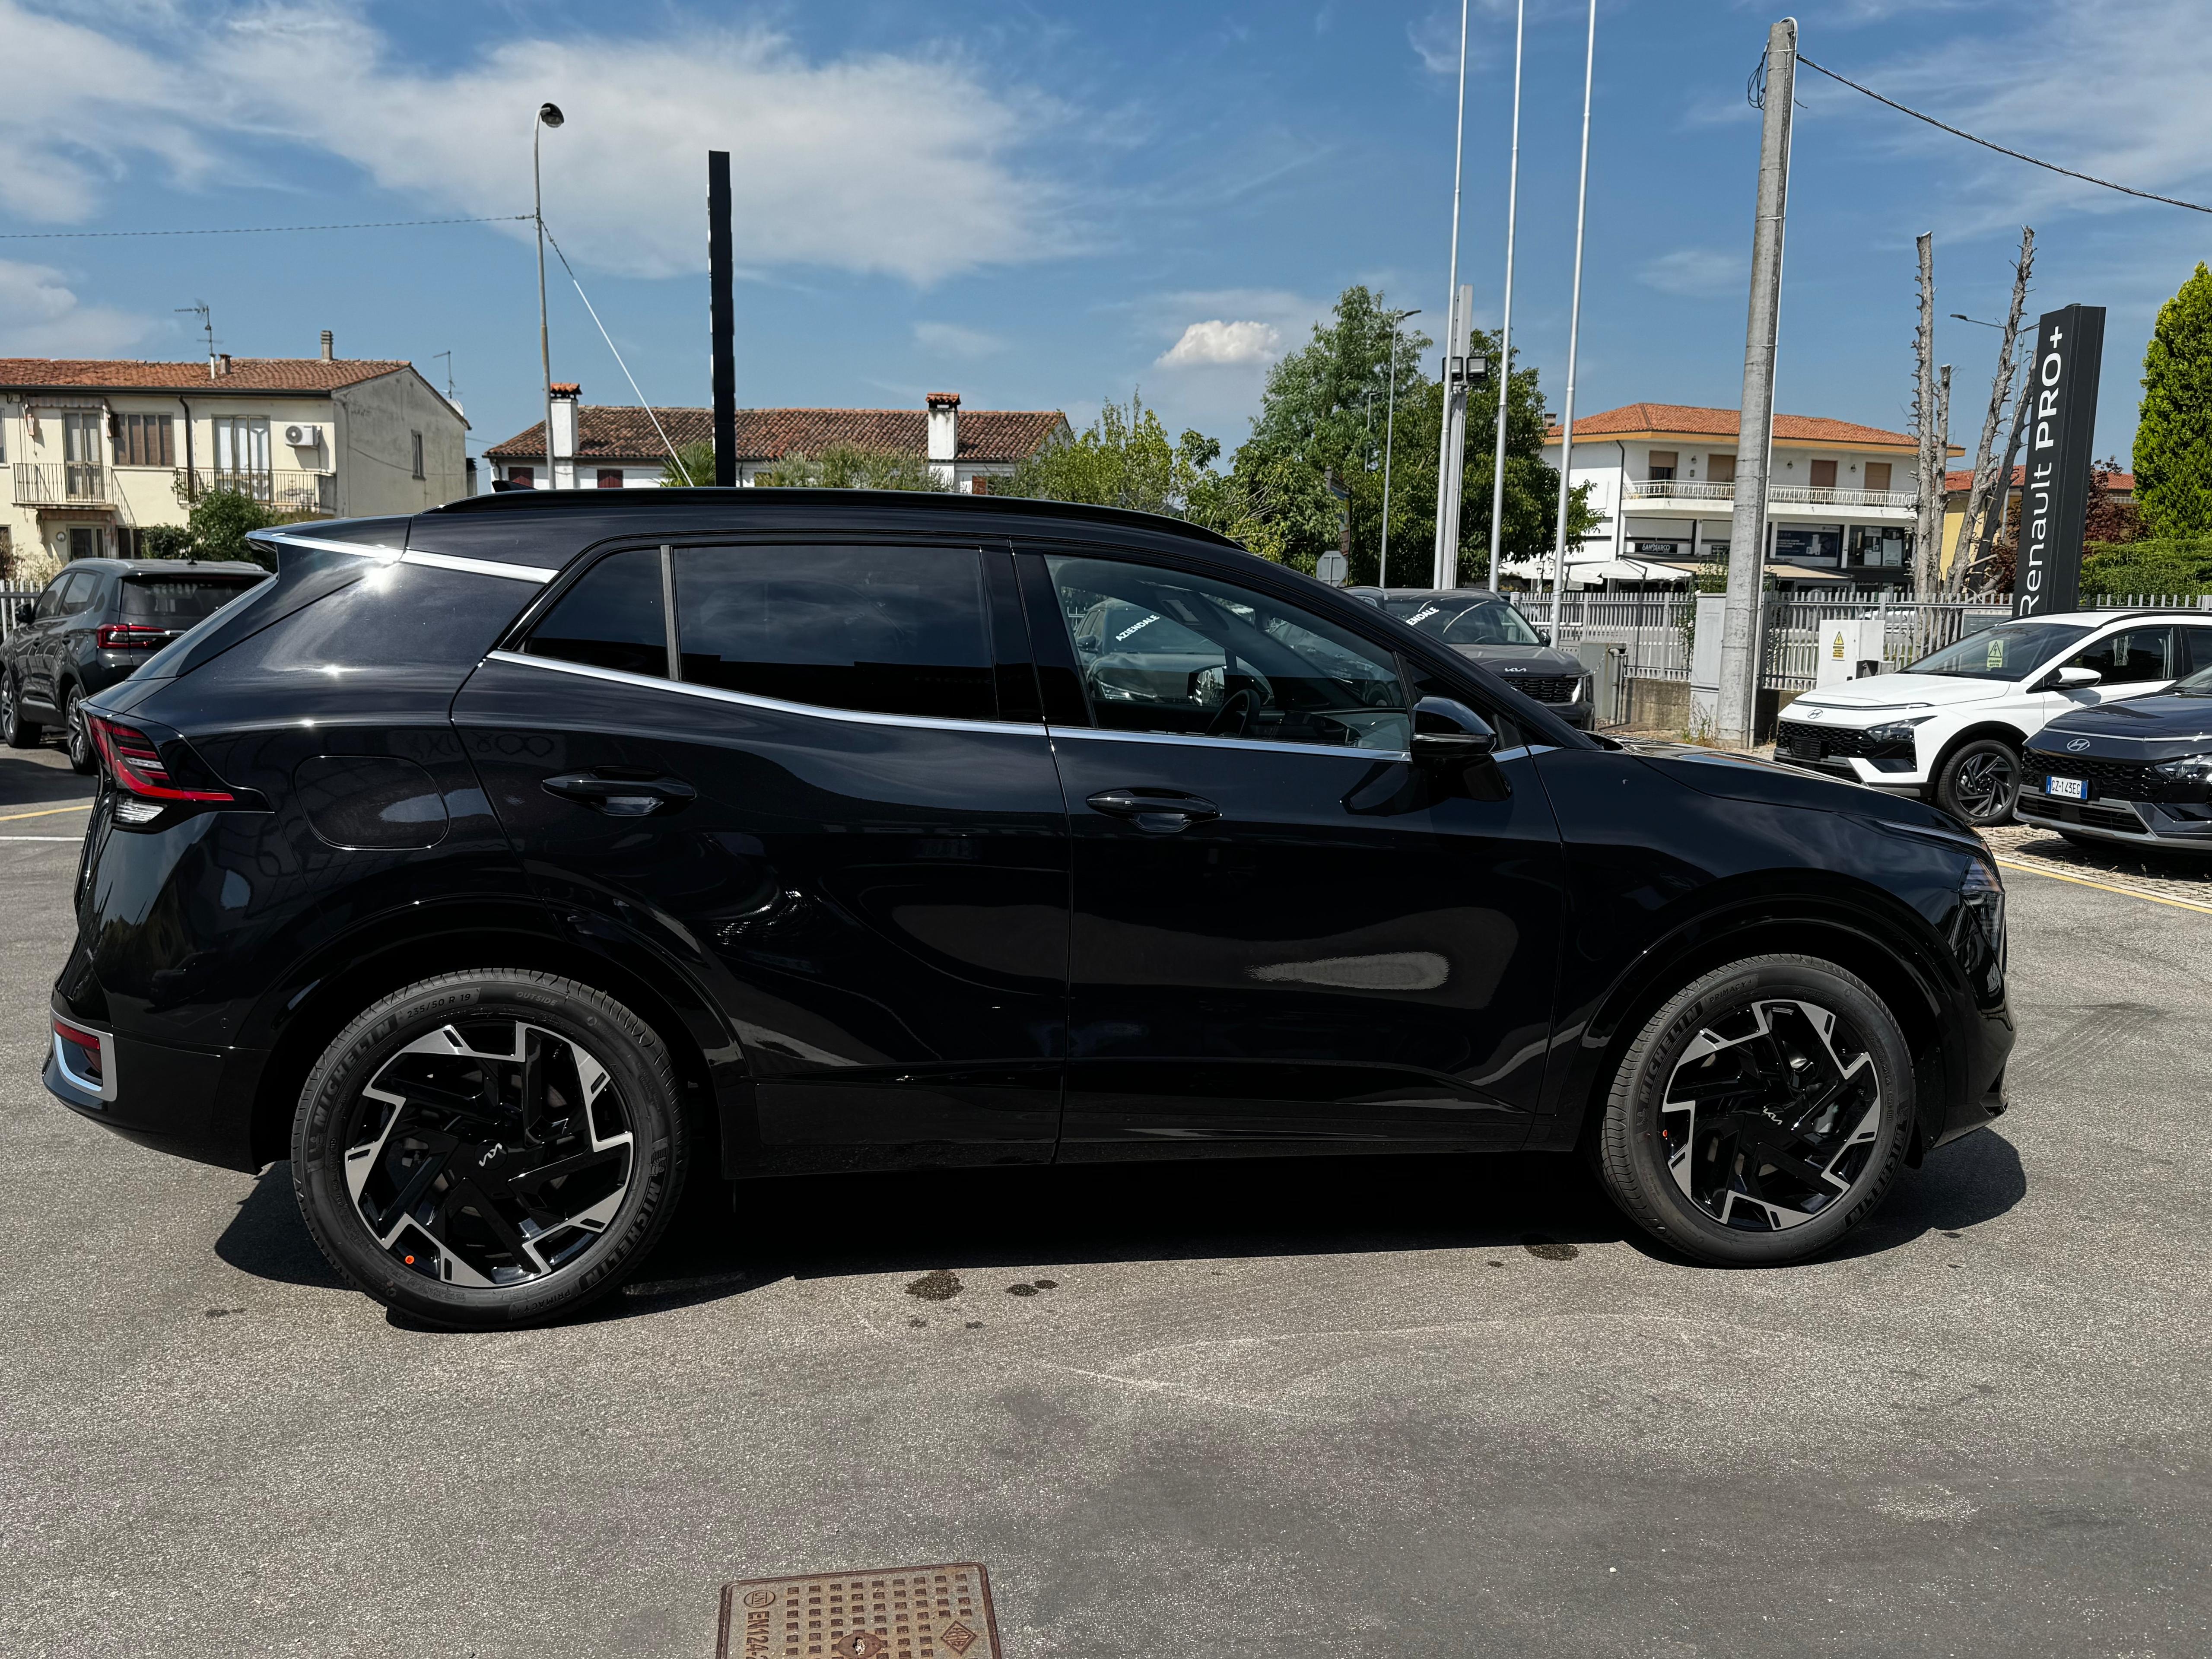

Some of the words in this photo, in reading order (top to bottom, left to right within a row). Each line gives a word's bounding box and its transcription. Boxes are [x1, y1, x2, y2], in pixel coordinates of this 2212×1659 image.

[2035, 326, 2063, 451] PRO+
[2019, 461, 2052, 616] Renault
[1116, 614, 1160, 641] AZIENDALE
[407, 998, 445, 1018] 235/50
[460, 993, 471, 1002] 19
[516, 991, 558, 1006] OUTSIDE
[1710, 981, 1746, 1003] PRIMACY
[313, 1020, 391, 1126] MICHELIN
[1639, 1004, 1699, 1103] MICHELIN
[1849, 1128, 1906, 1220] MICHELIN
[585, 1181, 661, 1283] MICHELIN
[524, 1289, 571, 1313] PRIMACY
